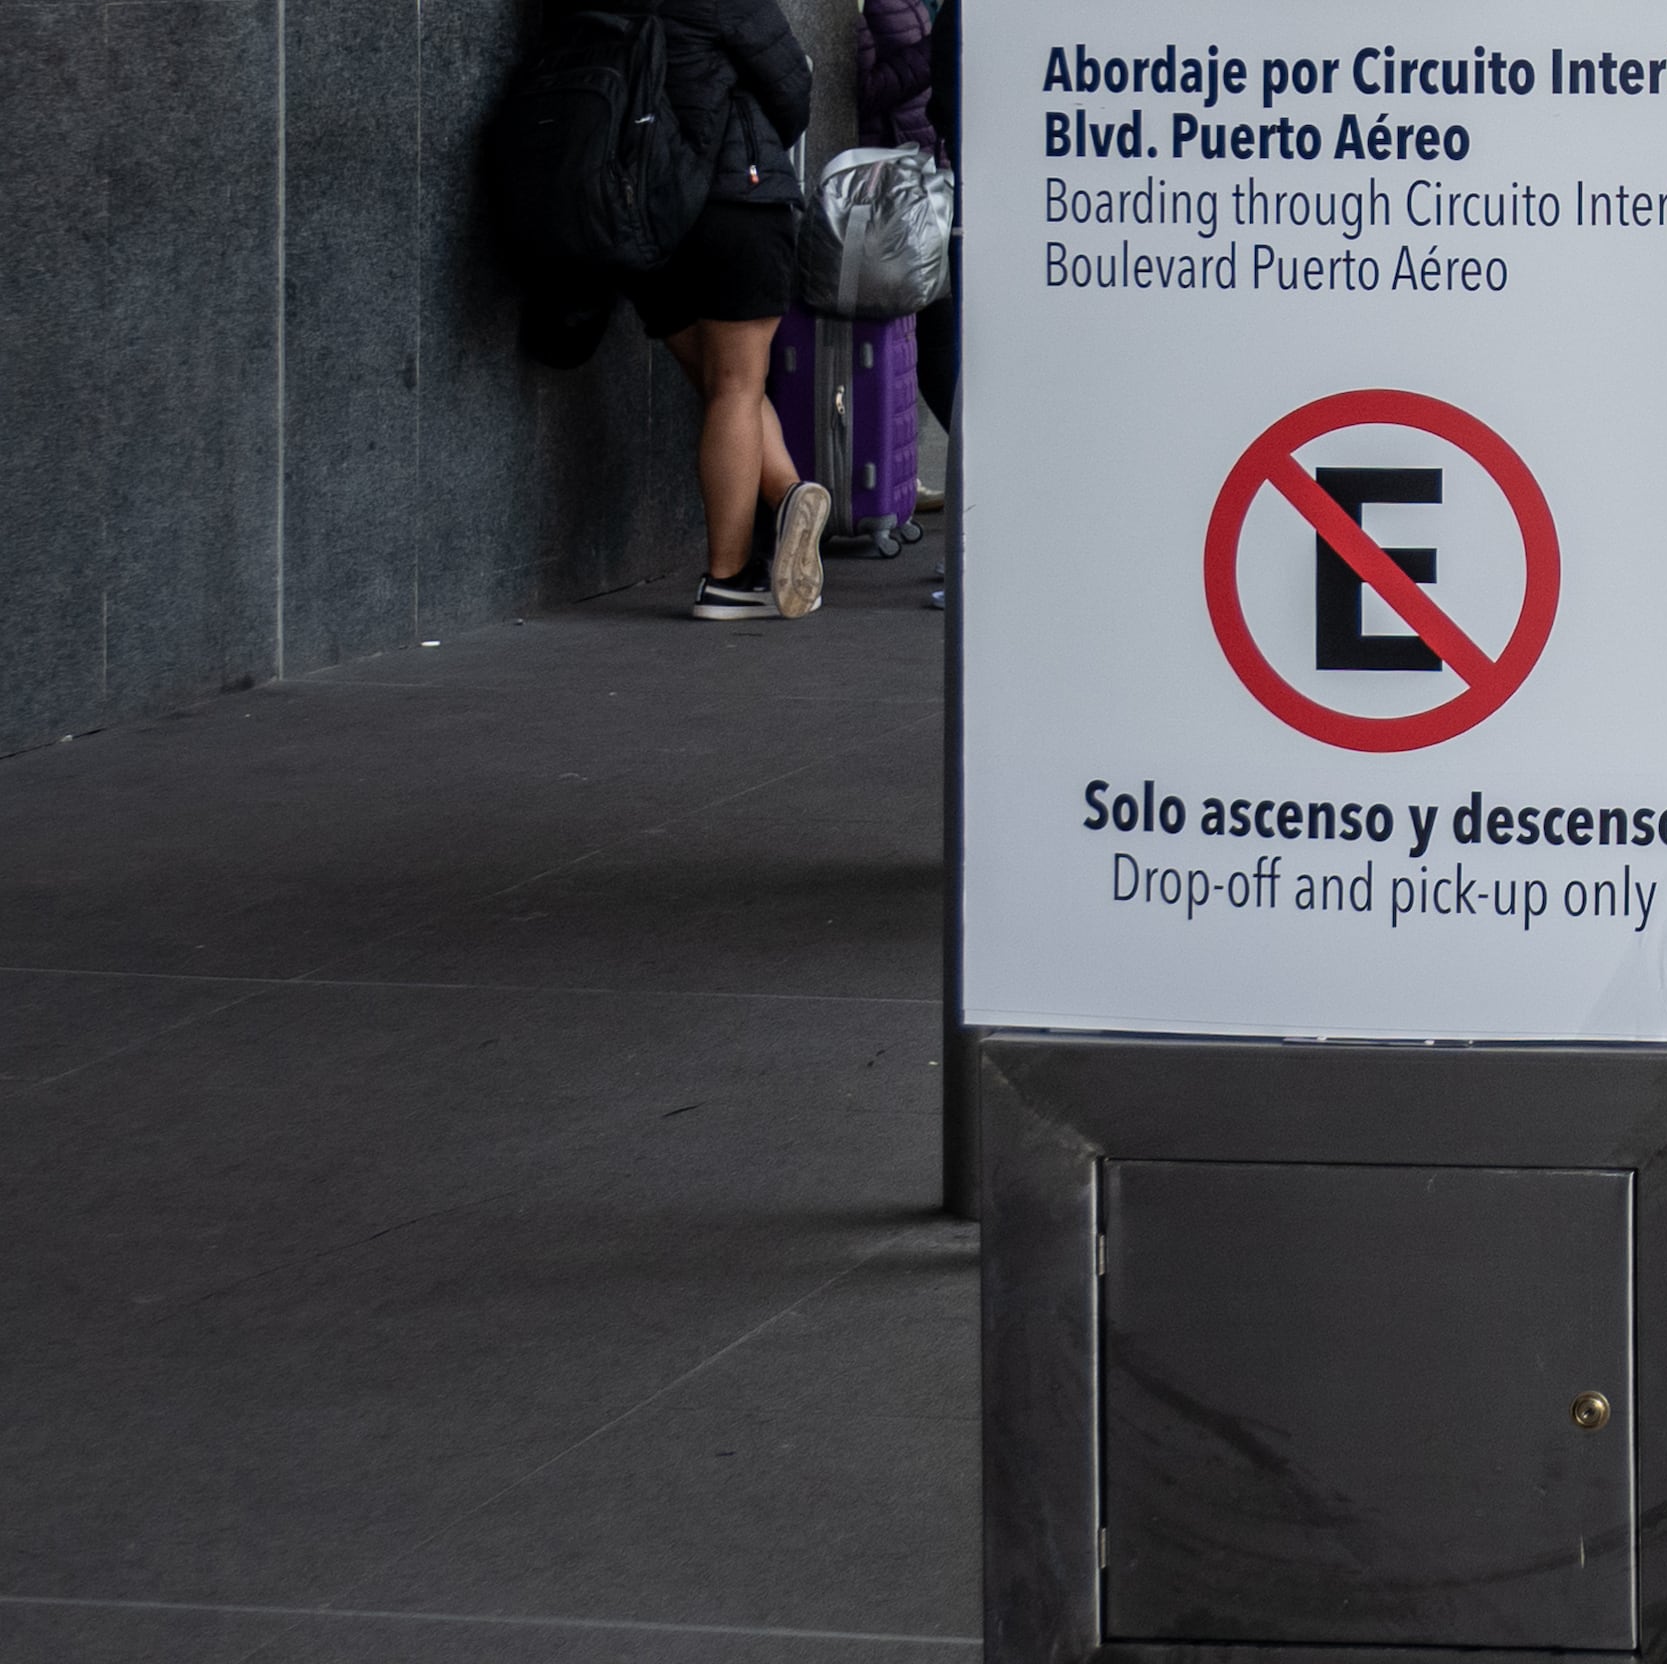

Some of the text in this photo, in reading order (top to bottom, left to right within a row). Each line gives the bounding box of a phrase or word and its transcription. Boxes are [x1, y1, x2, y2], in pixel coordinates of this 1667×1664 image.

[1043, 44, 1246, 107] Abordaje
[1263, 59, 1339, 108] por
[1353, 46, 1534, 95] Circuito
[1046, 109, 1469, 160] Blvd. Puerto Aéreo
[1047, 176, 1217, 238] Boarding
[1232, 177, 1389, 240] through
[1407, 180, 1559, 226] Circuito
[1047, 240, 1507, 291] Boulevard Puerto Aéreo
[1084, 780, 1185, 834] Solo
[1201, 798, 1393, 842] ascenso
[1409, 806, 1438, 858] y
[1114, 853, 1656, 932] Drop-off and pick-up only
